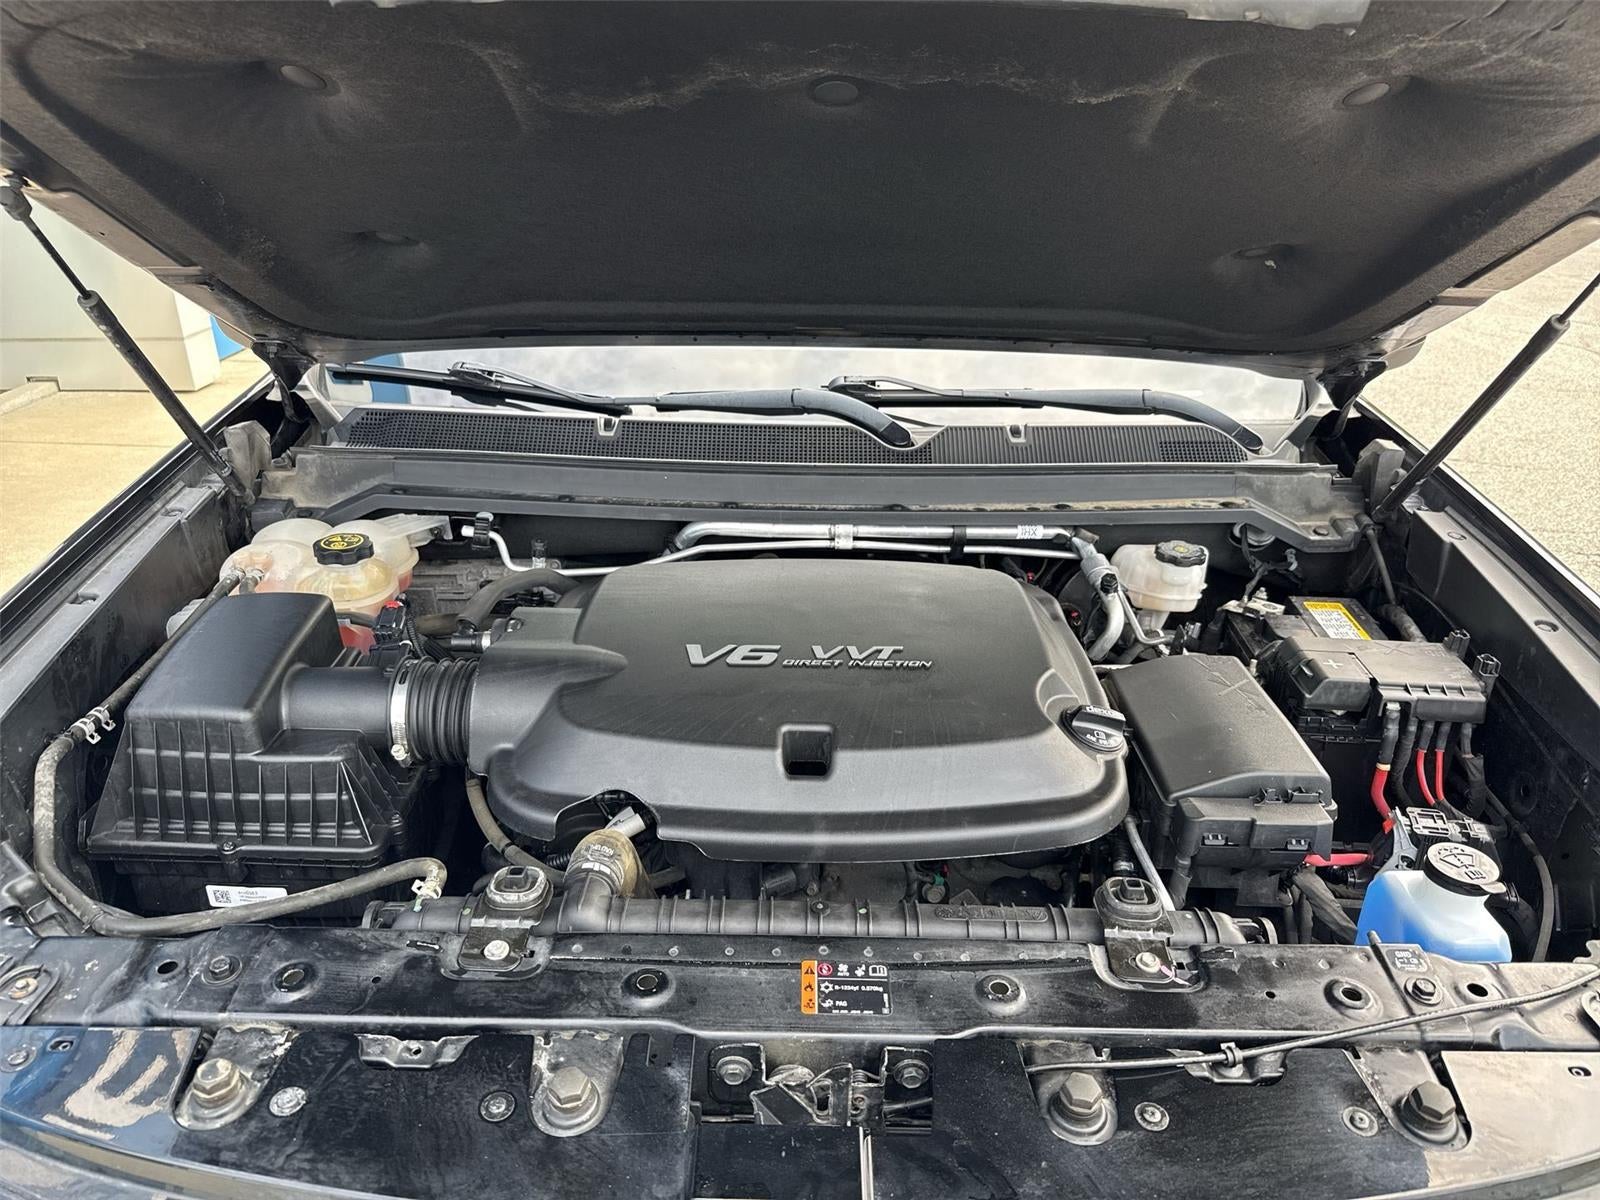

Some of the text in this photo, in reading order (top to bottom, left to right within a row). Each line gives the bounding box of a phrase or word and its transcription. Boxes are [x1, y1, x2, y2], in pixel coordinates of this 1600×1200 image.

[686, 643, 904, 667] V6 VVT
[782, 659, 932, 669] DIRECT INJECTION
[1394, 950, 1412, 958] GND
